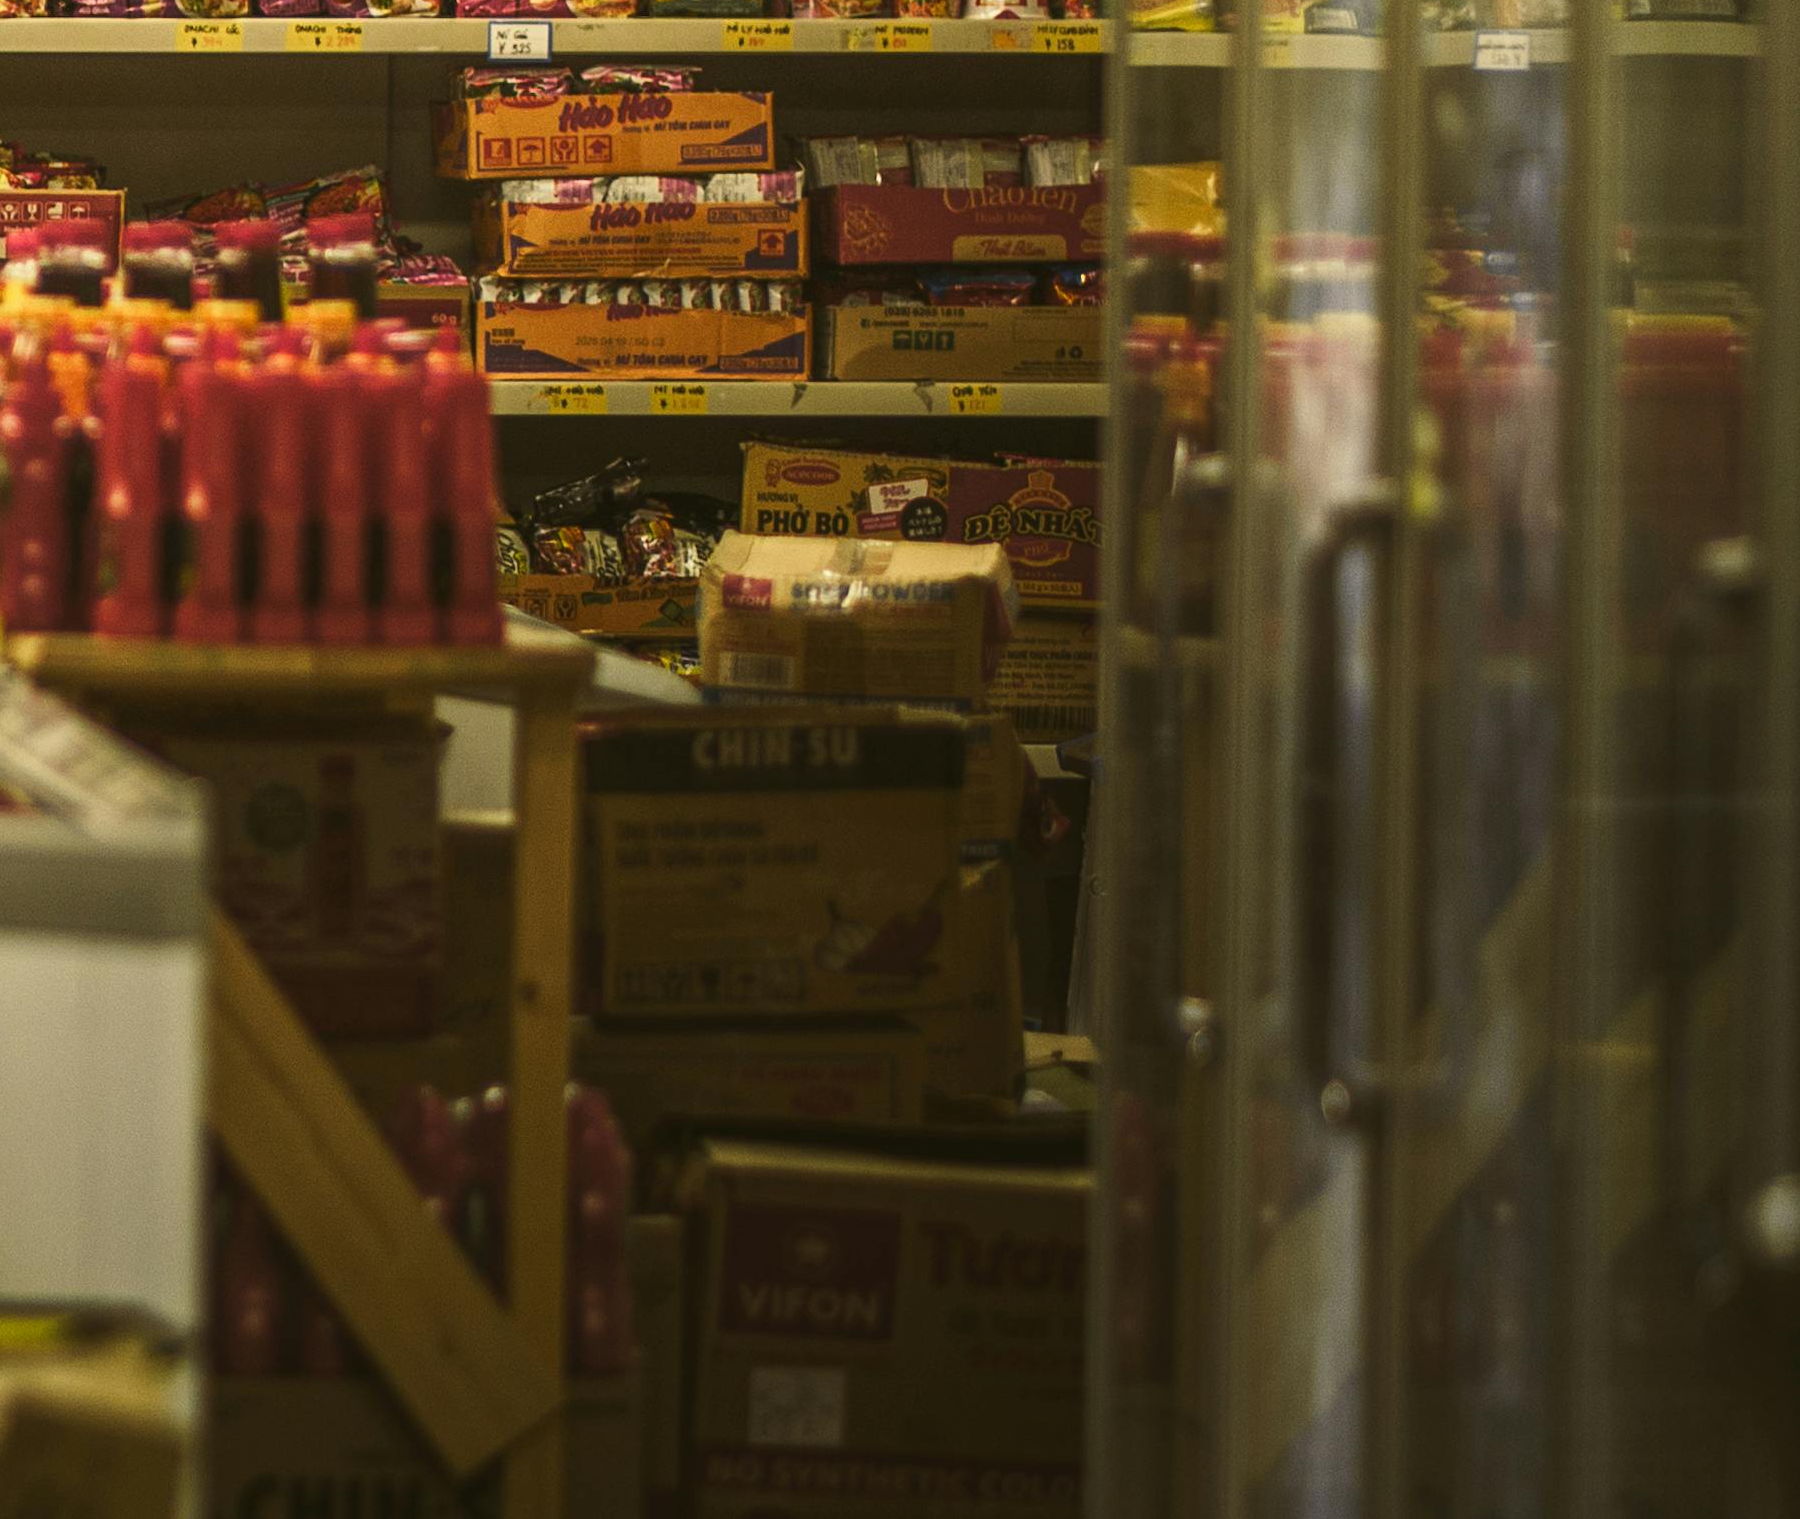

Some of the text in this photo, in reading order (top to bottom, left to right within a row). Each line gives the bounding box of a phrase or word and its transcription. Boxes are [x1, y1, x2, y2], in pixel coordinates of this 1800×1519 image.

[1056, 37, 1076, 51] 158
[756, 503, 849, 537] PHỞ BÒ
[690, 725, 860, 771] CHIN SU
[739, 1284, 882, 1329] VIFON
